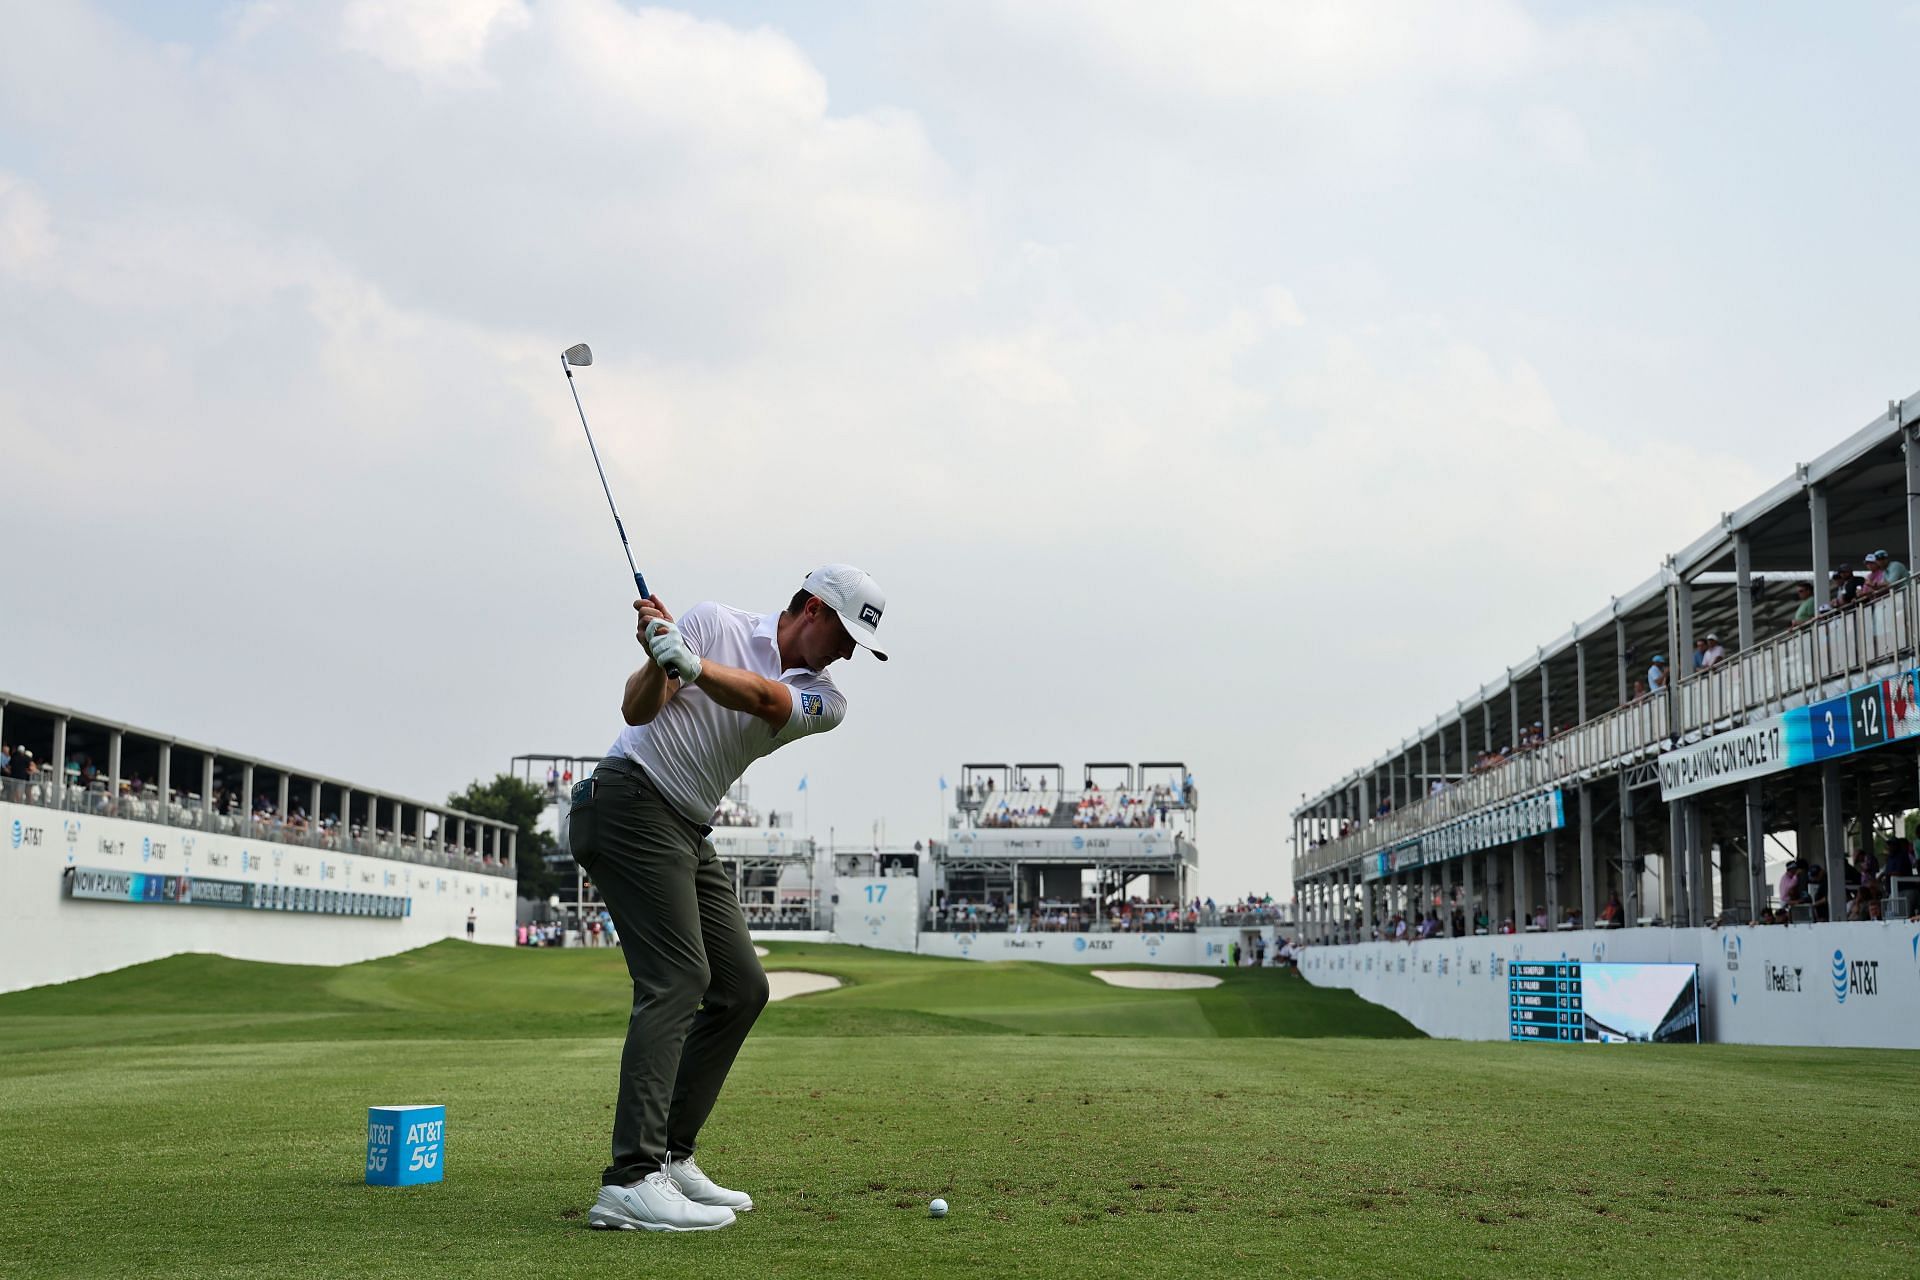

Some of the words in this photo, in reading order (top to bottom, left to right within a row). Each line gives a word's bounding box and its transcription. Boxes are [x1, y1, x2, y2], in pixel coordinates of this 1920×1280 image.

[862, 607, 879, 624] PIN
[1825, 710, 1835, 747] 3
[1856, 696, 1879, 737] -12
[1659, 759, 1679, 791] NOW
[1681, 749, 1720, 785] PLAYING
[1722, 743, 1737, 772] ON
[1738, 731, 1767, 768] HOLE
[1768, 727, 1779, 760] 17
[23, 827, 43, 846] AT&T
[74, 871, 94, 891] NOW
[94, 874, 131, 895] PLAYING
[864, 884, 888, 904] 17
[1088, 940, 1113, 950] AT&T
[1850, 960, 1879, 996] AT&T
[368, 1123, 394, 1145] AT&T
[406, 1120, 443, 1144] AT&T
[367, 1147, 388, 1172] 5G
[408, 1144, 439, 1171] 5G
